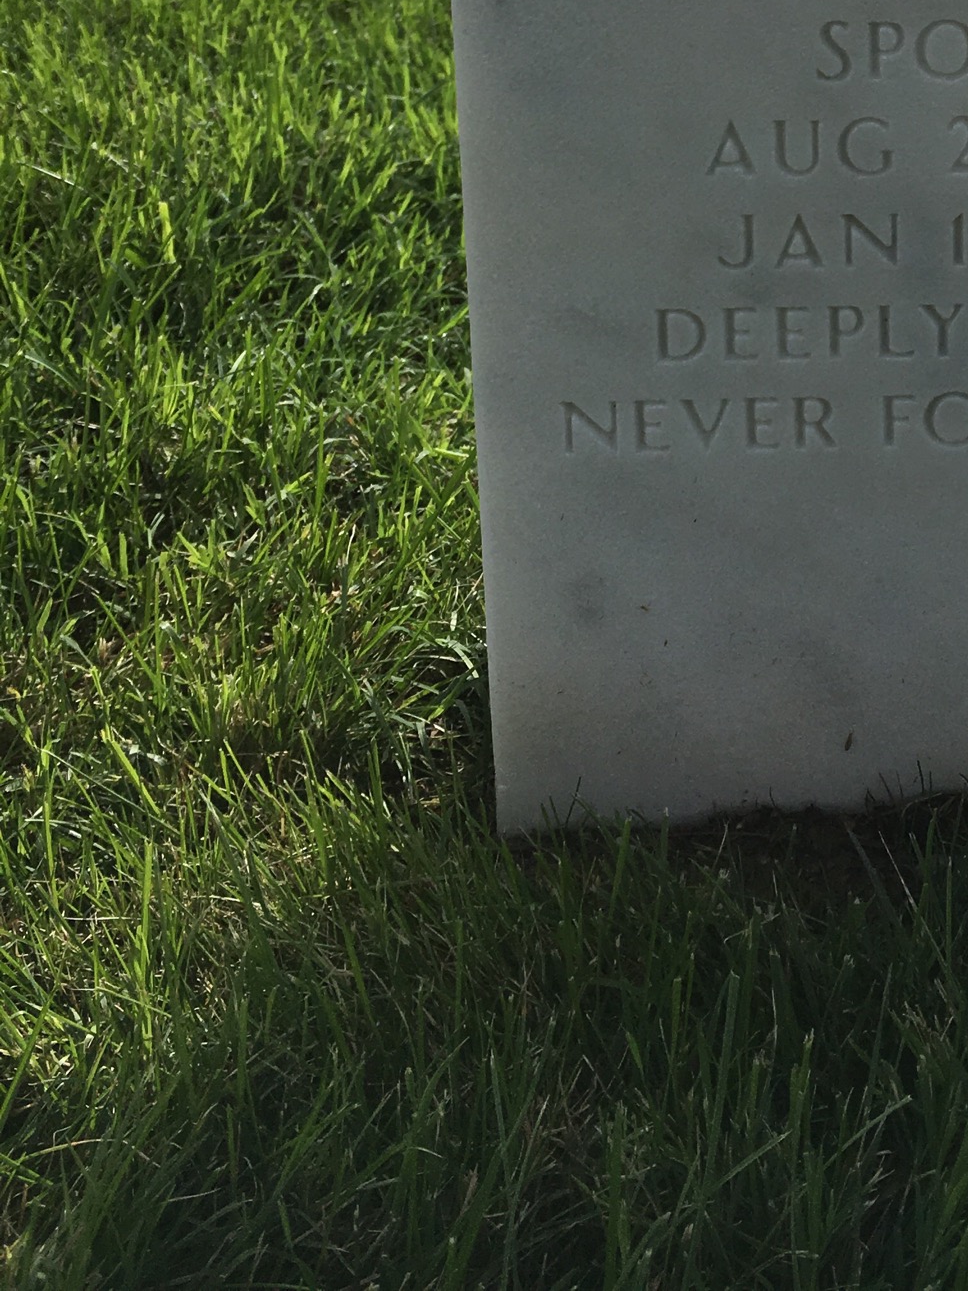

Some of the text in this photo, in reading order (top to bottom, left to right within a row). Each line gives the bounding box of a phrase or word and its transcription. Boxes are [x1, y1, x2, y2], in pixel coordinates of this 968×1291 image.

[705, 116, 895, 178] AUG
[716, 211, 901, 272] JAN
[658, 303, 964, 364] DEEPLY
[562, 395, 837, 455] NEVER
